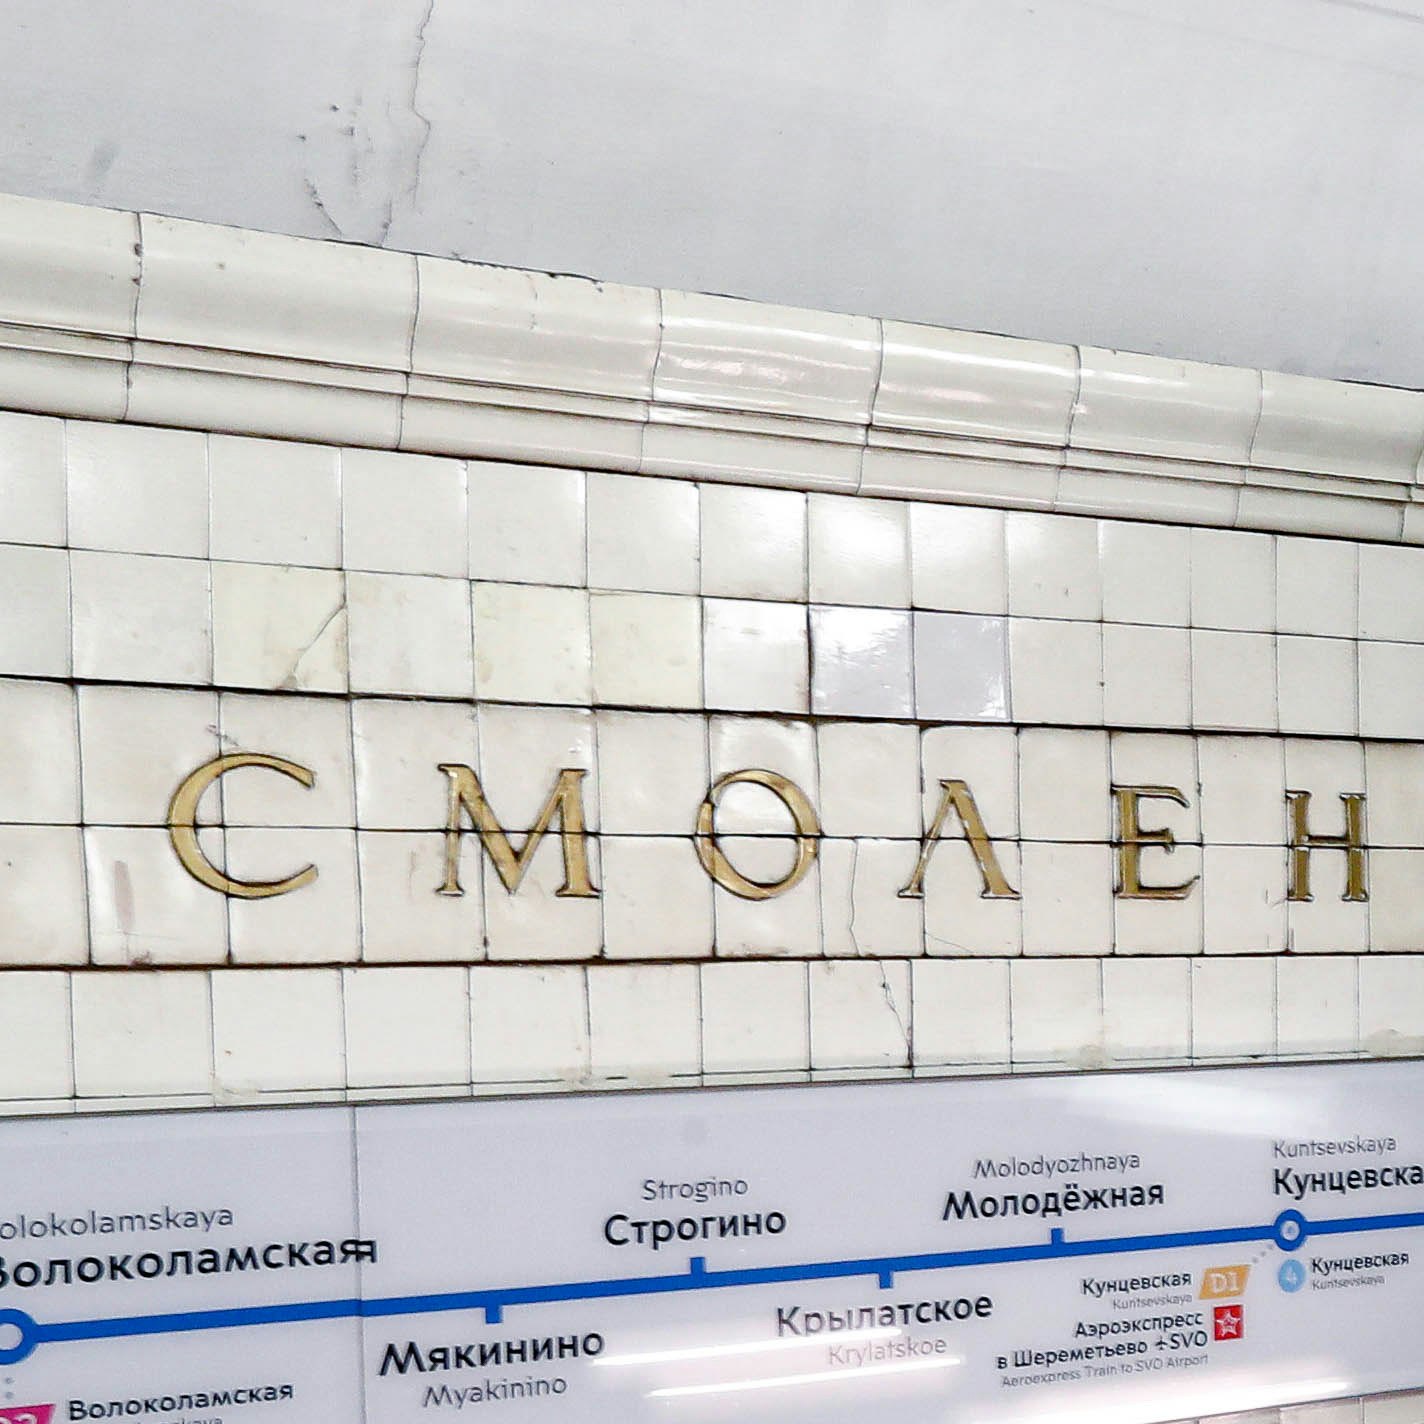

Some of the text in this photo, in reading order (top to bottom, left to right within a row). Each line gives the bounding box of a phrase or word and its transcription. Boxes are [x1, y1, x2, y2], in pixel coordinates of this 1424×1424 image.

[1274, 1135, 1396, 1159] Kuntsevskaya
[973, 1152, 1141, 1179] Molodyozhnaya
[642, 1176, 749, 1203] Strogino
[942, 1183, 1165, 1222] Молодёжная
[0, 1204, 234, 1241] olokolamskaya
[604, 1210, 787, 1250] Строгино
[1311, 1253, 1410, 1276] Кунцевская
[1082, 1272, 1193, 1299] Кунцевская
[1209, 1272, 1240, 1294] D1
[1312, 1274, 1386, 1291] Kuntsevskaya
[777, 1296, 994, 1338] Крылатское
[1112, 1294, 1193, 1312] Kuntsevskaya
[1074, 1312, 1204, 1340] Аэроэкспресс
[378, 1331, 605, 1377] Мякинино
[828, 1334, 948, 1368] Krylatskoe
[997, 1330, 1208, 1370] в Шереметьево SVO
[1001, 1354, 1209, 1390] Aeroexpress Train to SVO Airport
[69, 1383, 294, 1422] Волоколамская
[422, 1374, 568, 1410] Myakinino
